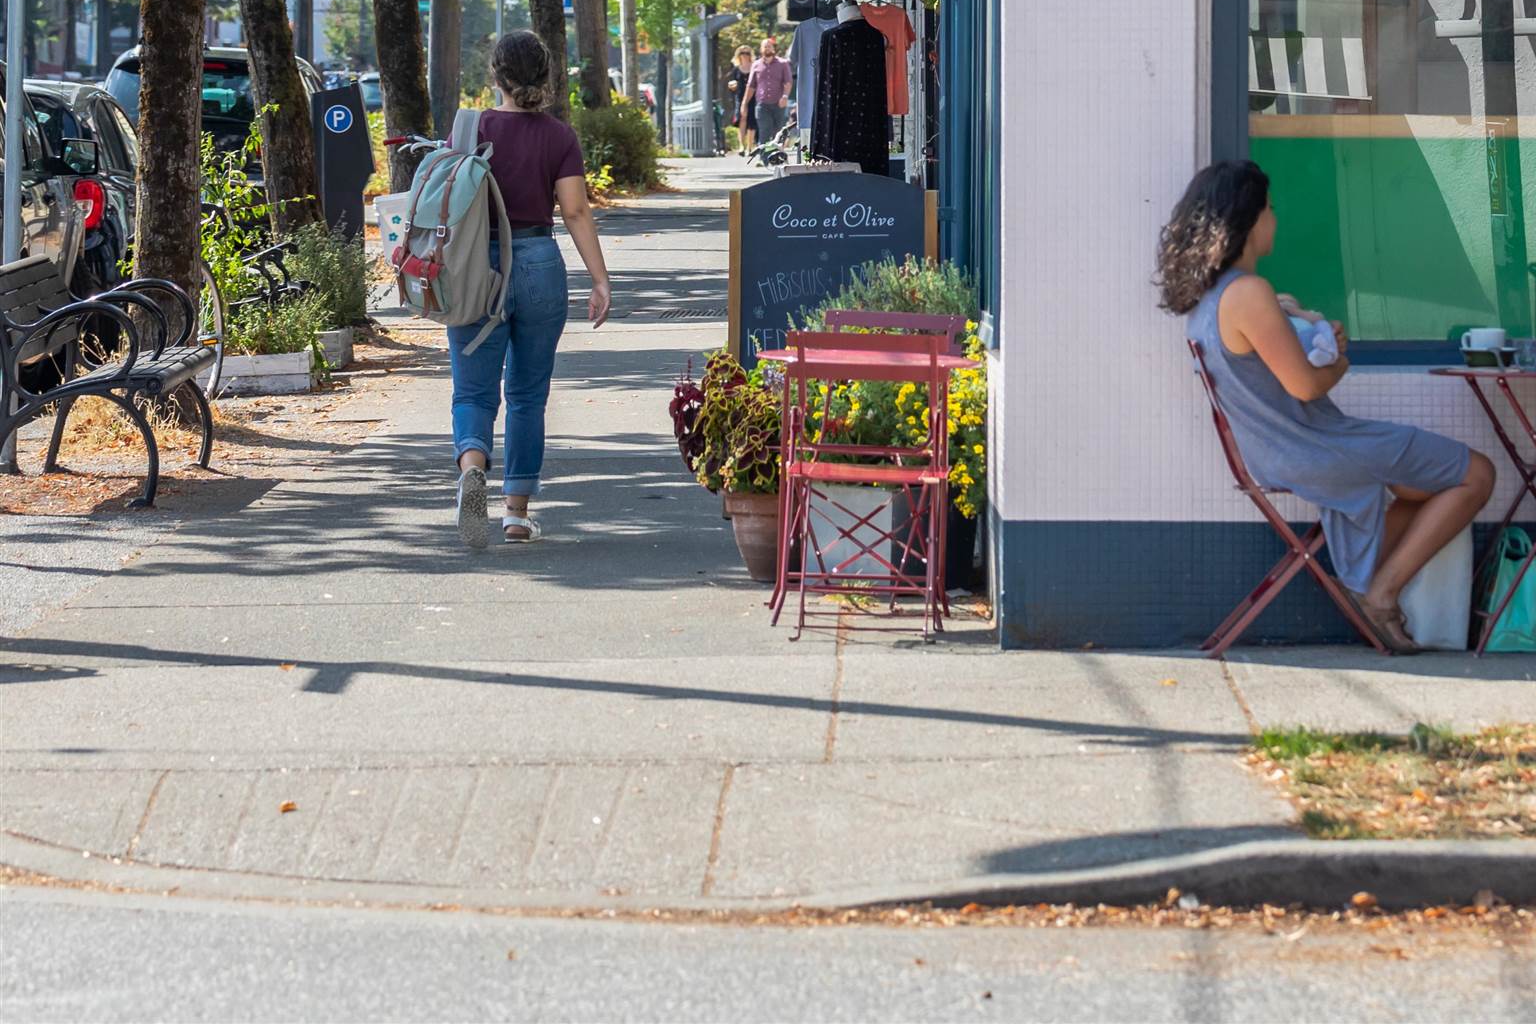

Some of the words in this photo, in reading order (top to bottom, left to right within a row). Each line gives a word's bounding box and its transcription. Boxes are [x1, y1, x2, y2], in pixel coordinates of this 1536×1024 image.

[333, 111, 345, 127] P
[772, 204, 817, 228] Coco
[823, 215, 837, 227] et
[843, 203, 895, 227] Olive
